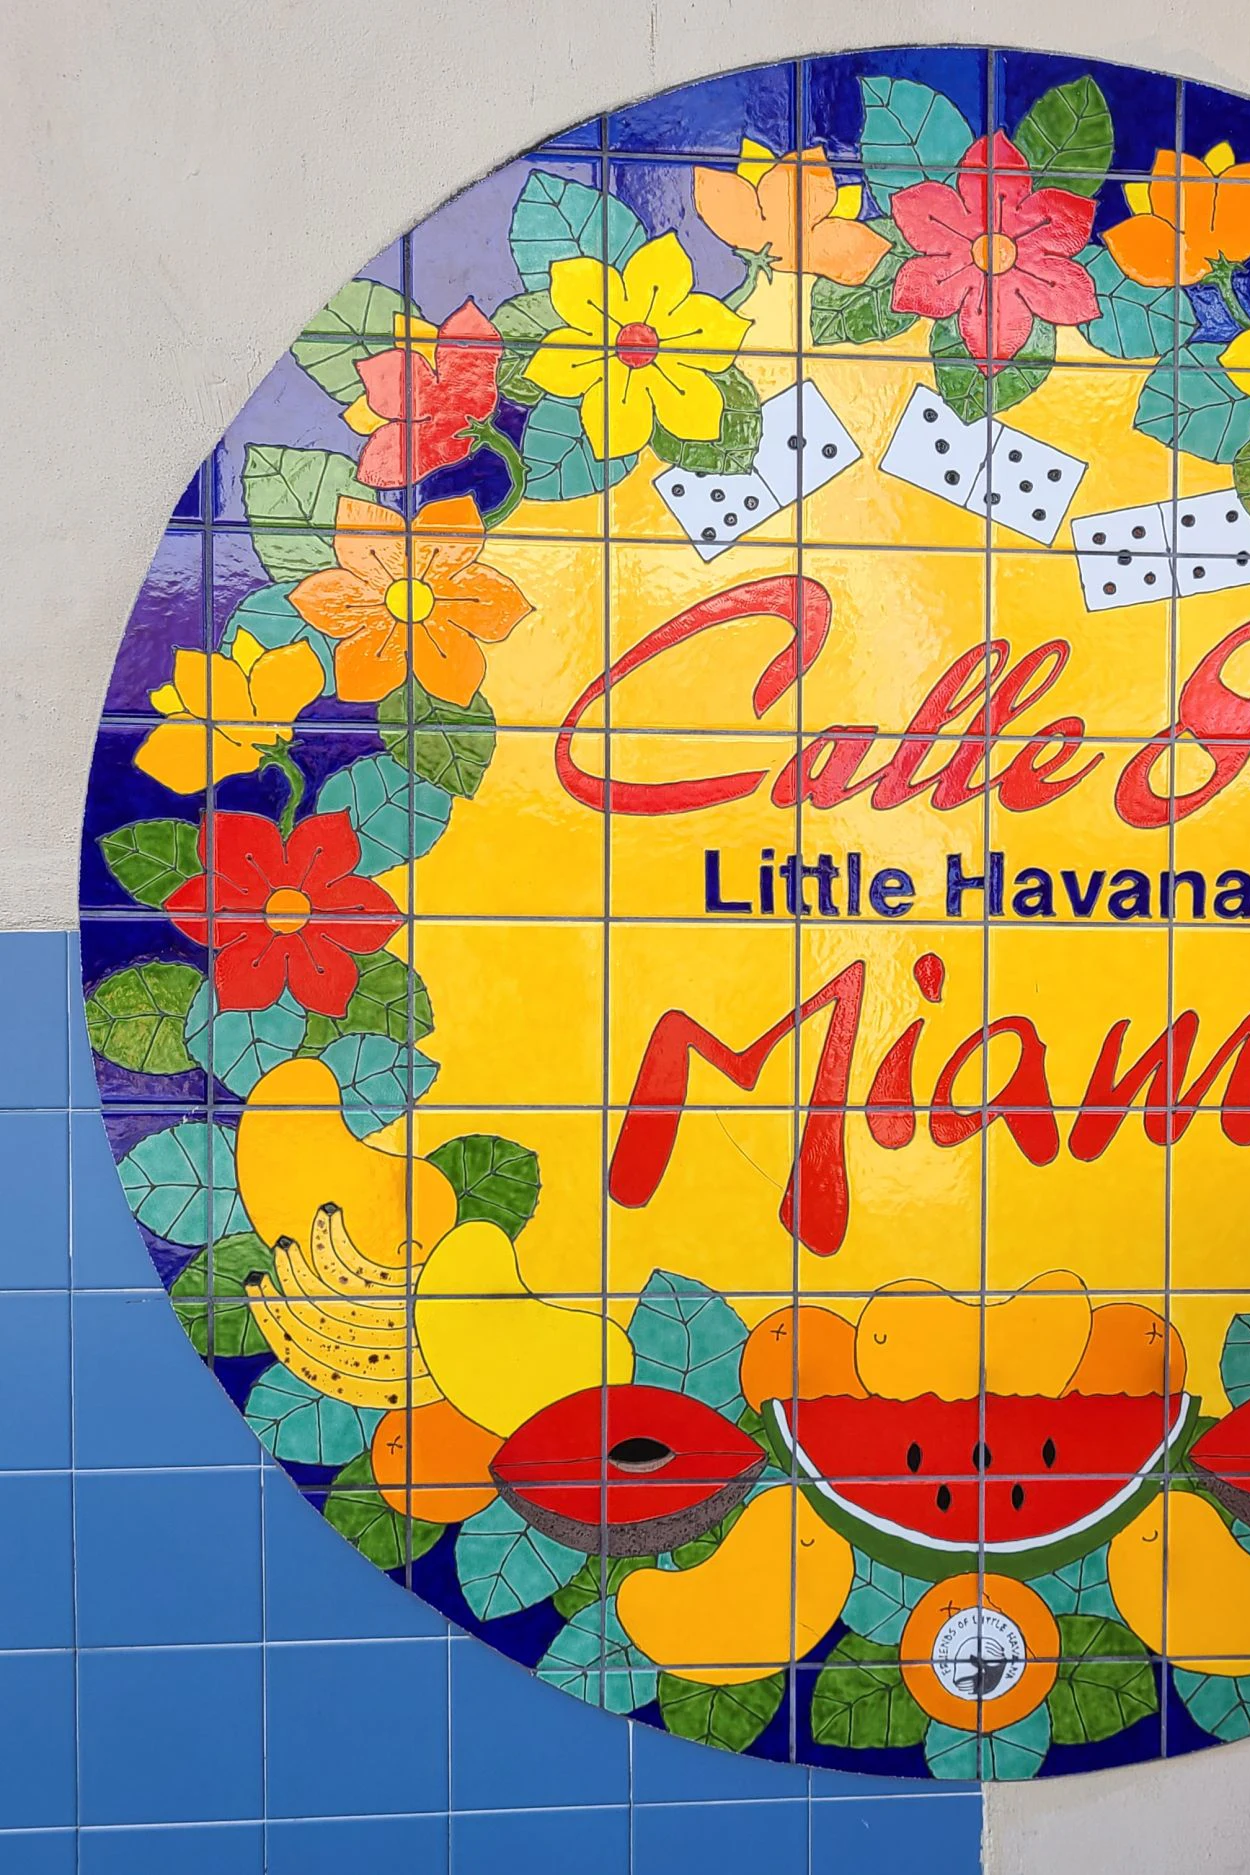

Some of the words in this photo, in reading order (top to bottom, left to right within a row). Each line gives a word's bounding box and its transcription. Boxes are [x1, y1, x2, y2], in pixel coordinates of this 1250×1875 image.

[555, 575, 1104, 816] Calle
[703, 850, 914, 918] Little
[939, 1628, 957, 1676] FRIENDS
[958, 1617, 969, 1629] OF
[972, 1615, 1008, 1632] LITTLE
[1005, 1631, 1021, 1680] HAVANA
